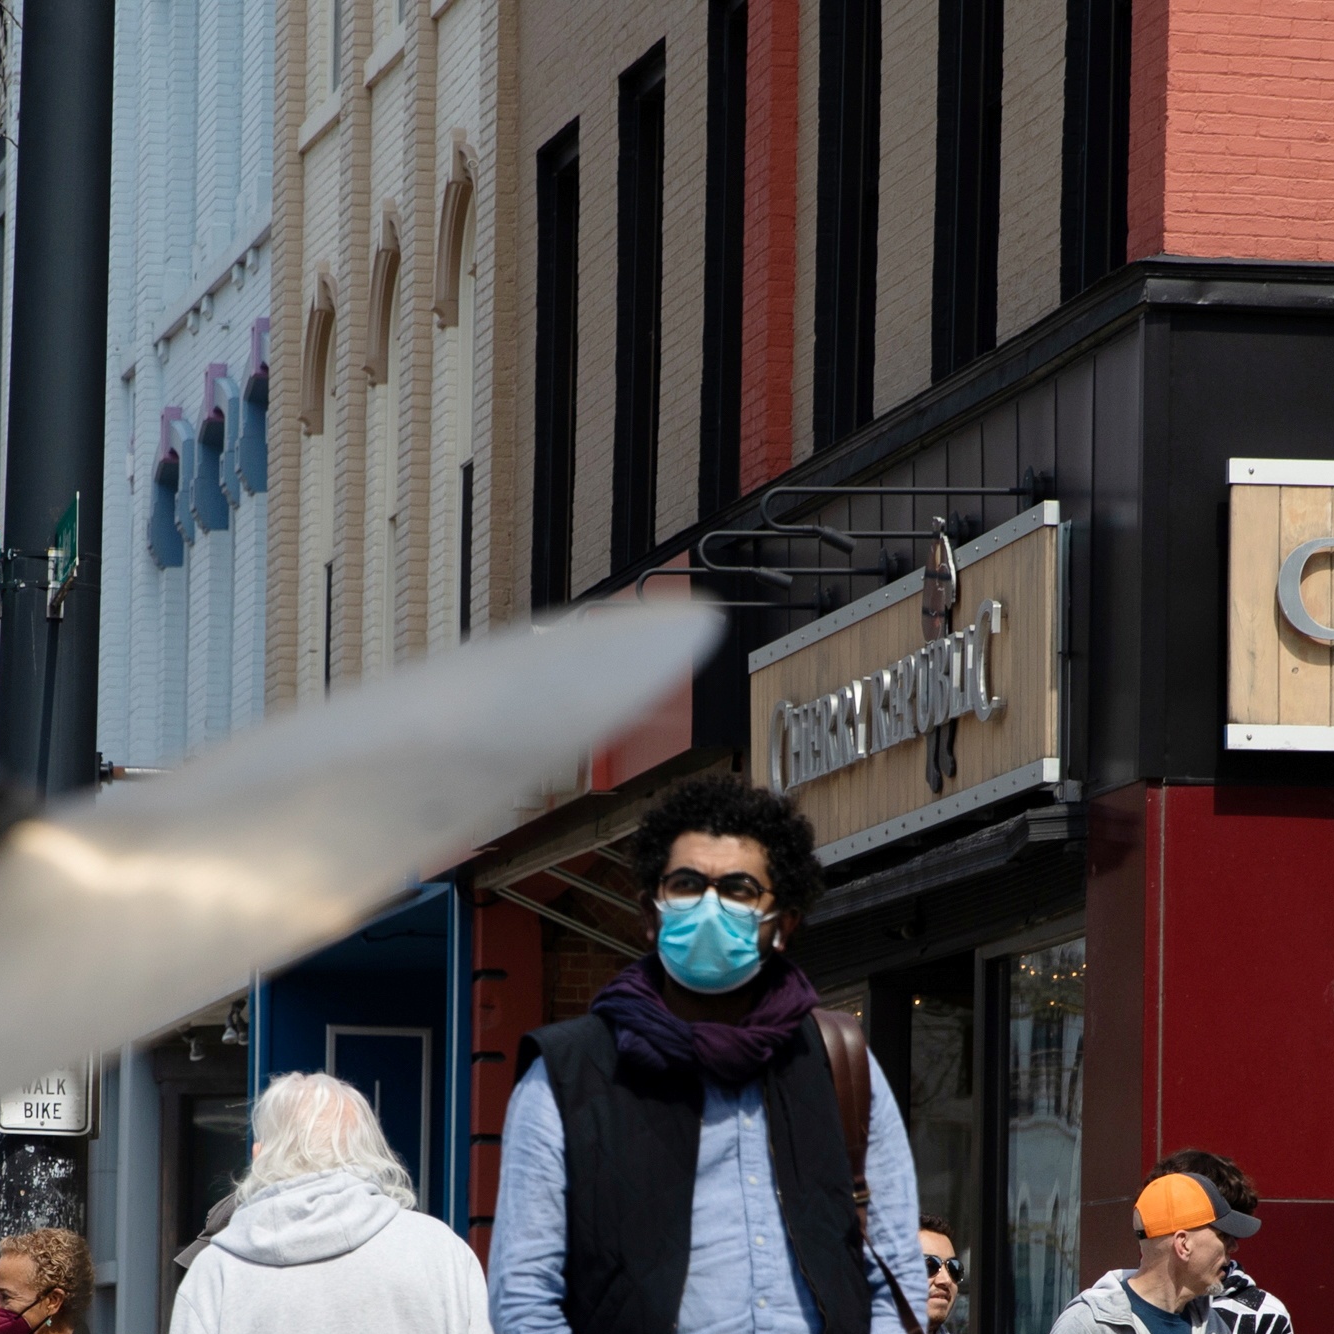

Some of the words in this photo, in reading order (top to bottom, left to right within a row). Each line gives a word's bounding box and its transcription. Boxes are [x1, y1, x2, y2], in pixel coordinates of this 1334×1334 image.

[770, 676, 871, 798] CHERRY
[869, 598, 1002, 756] REPUBLIC
[21, 1077, 67, 1096] WALK
[23, 1102, 62, 1120] BIKE
